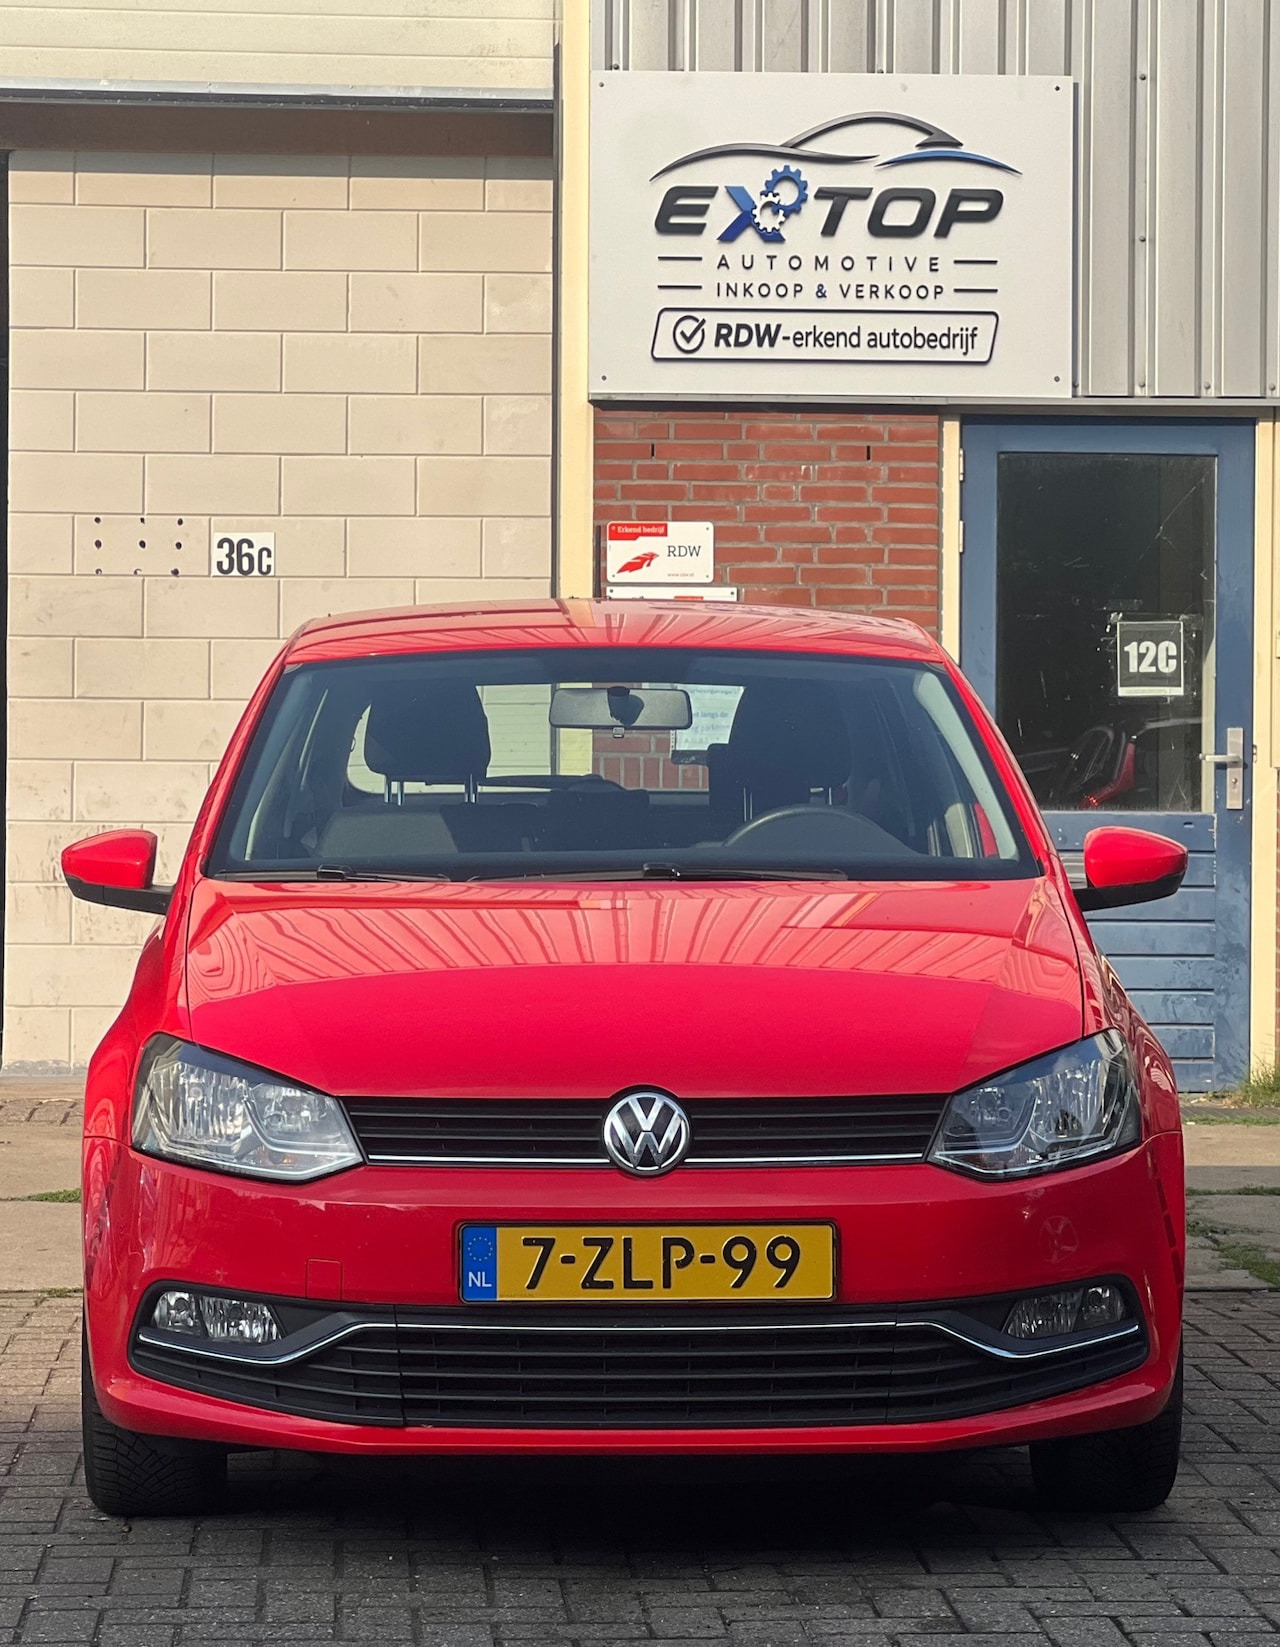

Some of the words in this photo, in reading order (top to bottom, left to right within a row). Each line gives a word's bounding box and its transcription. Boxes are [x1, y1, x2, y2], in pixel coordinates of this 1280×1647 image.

[716, 254, 941, 272] AUTOMOTIVE
[716, 282, 804, 298] INKOOP
[814, 283, 828, 299] &
[839, 283, 945, 300] VERKOOP
[714, 322, 861, 350] RDW-erkend
[866, 325, 979, 356] autobedrijf
[617, 525, 641, 533] Erkend
[667, 545, 701, 557] RDW
[1124, 640, 1177, 673] 12C
[521, 1235, 801, 1290] 7-ZLP-99
[468, 1271, 492, 1288] NL
